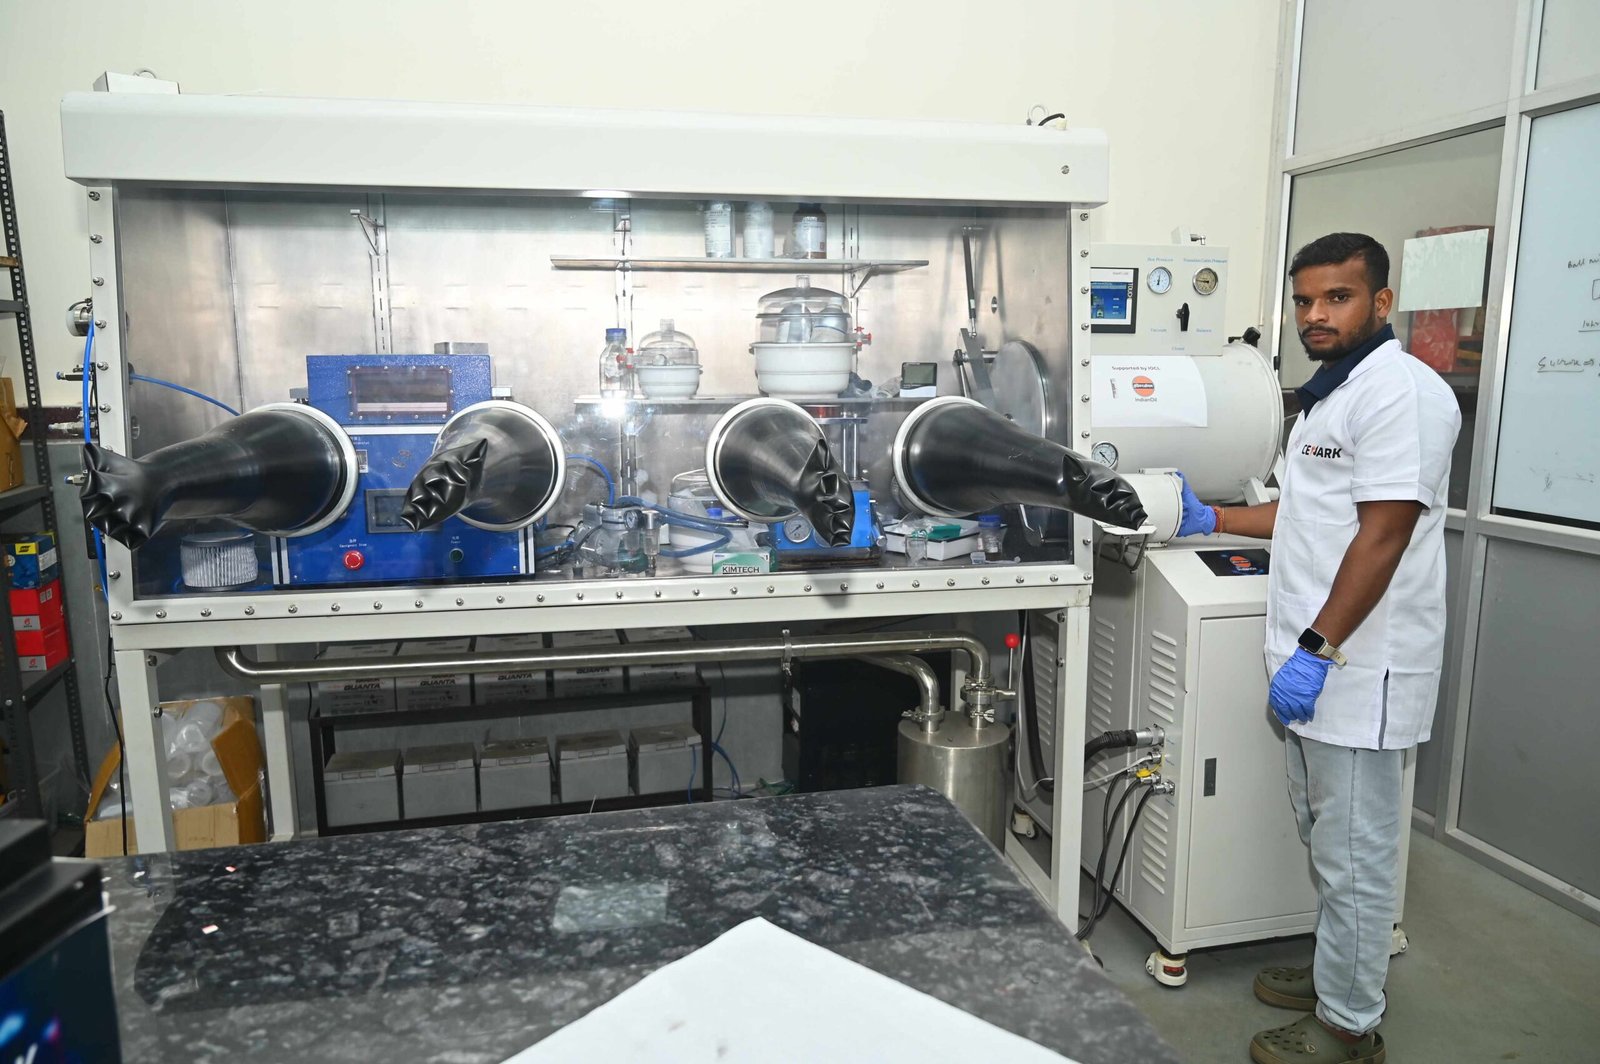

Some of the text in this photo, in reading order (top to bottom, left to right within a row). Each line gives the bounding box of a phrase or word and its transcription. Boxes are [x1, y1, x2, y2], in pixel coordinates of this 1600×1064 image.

[497, 673, 532, 681] QUANTA
[343, 683, 381, 691] QUANTA
[420, 679, 456, 687] QUANTA
